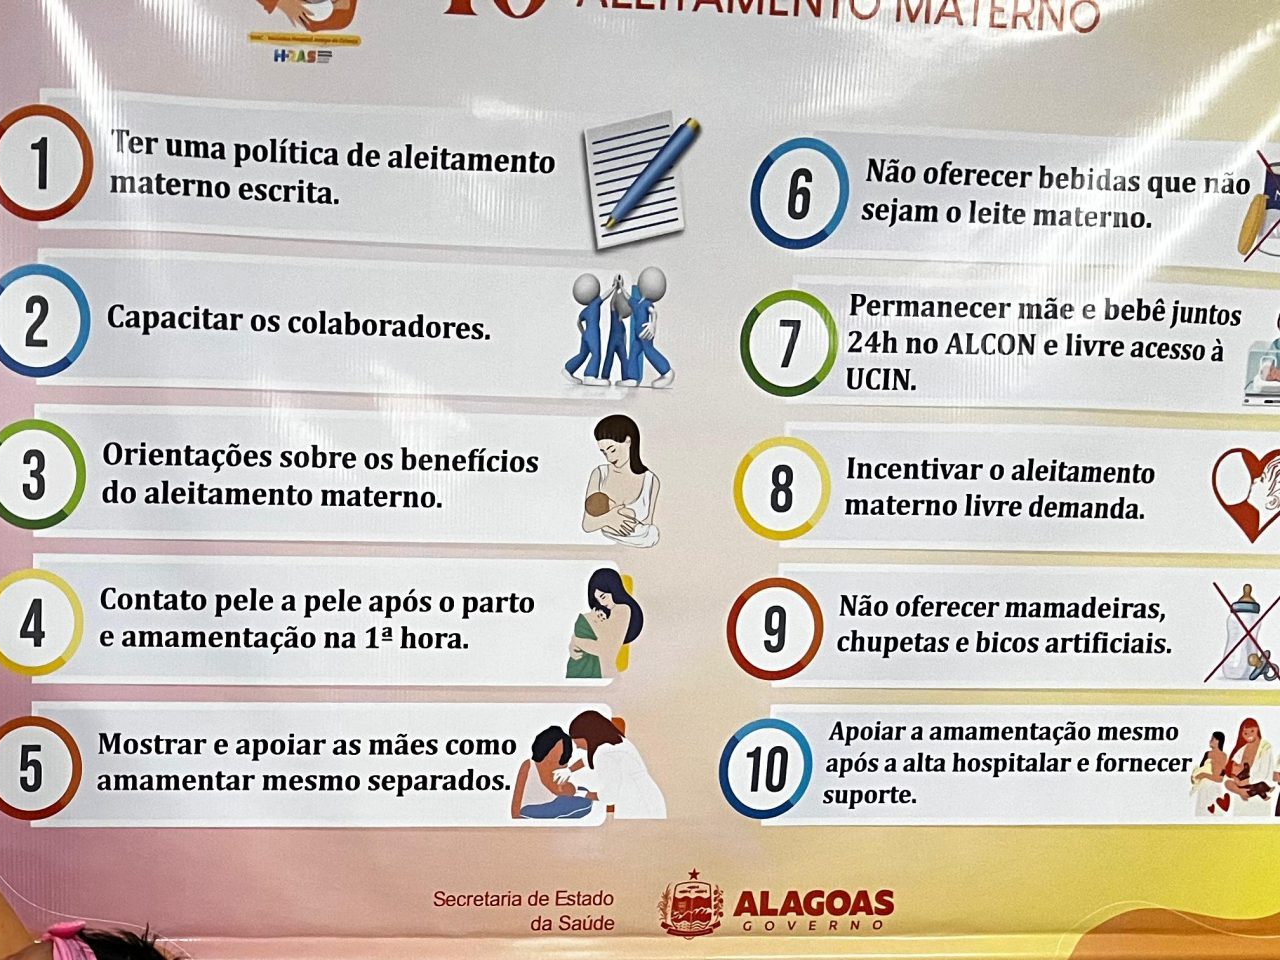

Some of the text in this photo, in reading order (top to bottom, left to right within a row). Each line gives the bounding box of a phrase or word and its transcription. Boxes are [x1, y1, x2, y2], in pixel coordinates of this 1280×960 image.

[896, 0, 1100, 33] MATERNO
[31, 137, 47, 189] 1
[112, 129, 555, 173] Ter uma política de aleitamento
[110, 174, 339, 204] materno escrita.
[866, 159, 1250, 198] Não oferecer bebidas que não
[788, 168, 812, 220] 6
[862, 198, 1151, 228] sejam o leite materno.
[26, 295, 48, 347] 2
[108, 304, 490, 340] Capacitar os colaboradores.
[850, 294, 1241, 328] Permanecer mãe e bebê juntos
[780, 320, 801, 368] 7
[848, 331, 1223, 361] 24h no ALCON e livre acesso à
[847, 368, 916, 390] UCIN.
[103, 442, 538, 473] Orientações sobre os benefícios
[847, 457, 1154, 484] Incentivar o aleitamento
[23, 449, 45, 500] 3
[771, 465, 793, 512] 8
[103, 480, 442, 508] do aleitamento materno.
[845, 494, 1144, 519] materno livre demanda.
[101, 588, 534, 619] Contato pele a pele após o parto
[840, 595, 1165, 622] Não oferecer mamadeiras,
[20, 599, 45, 647] 4
[764, 606, 786, 653] 9
[100, 631, 114, 646] e
[122, 626, 316, 654] amamentação
[324, 632, 356, 648] na
[400, 626, 468, 649] hora.
[837, 630, 1171, 658] chupetas e bicos artificiais.
[98, 733, 516, 761] Mostrar e apoiar as mães como
[829, 721, 1178, 746] Apoiar a amamentação mesmo
[20, 745, 42, 792] 5
[747, 746, 788, 792] 10
[826, 752, 1192, 778] após a alta hospitalar e fornecer
[97, 769, 510, 797] amamentar mesmo separados.
[823, 787, 916, 809] suporte.
[434, 890, 614, 906] Secretaria de Estado
[733, 890, 894, 916] ALAGOAS
[531, 915, 614, 931] da Saúde
[743, 920, 882, 931] GOVERNO
